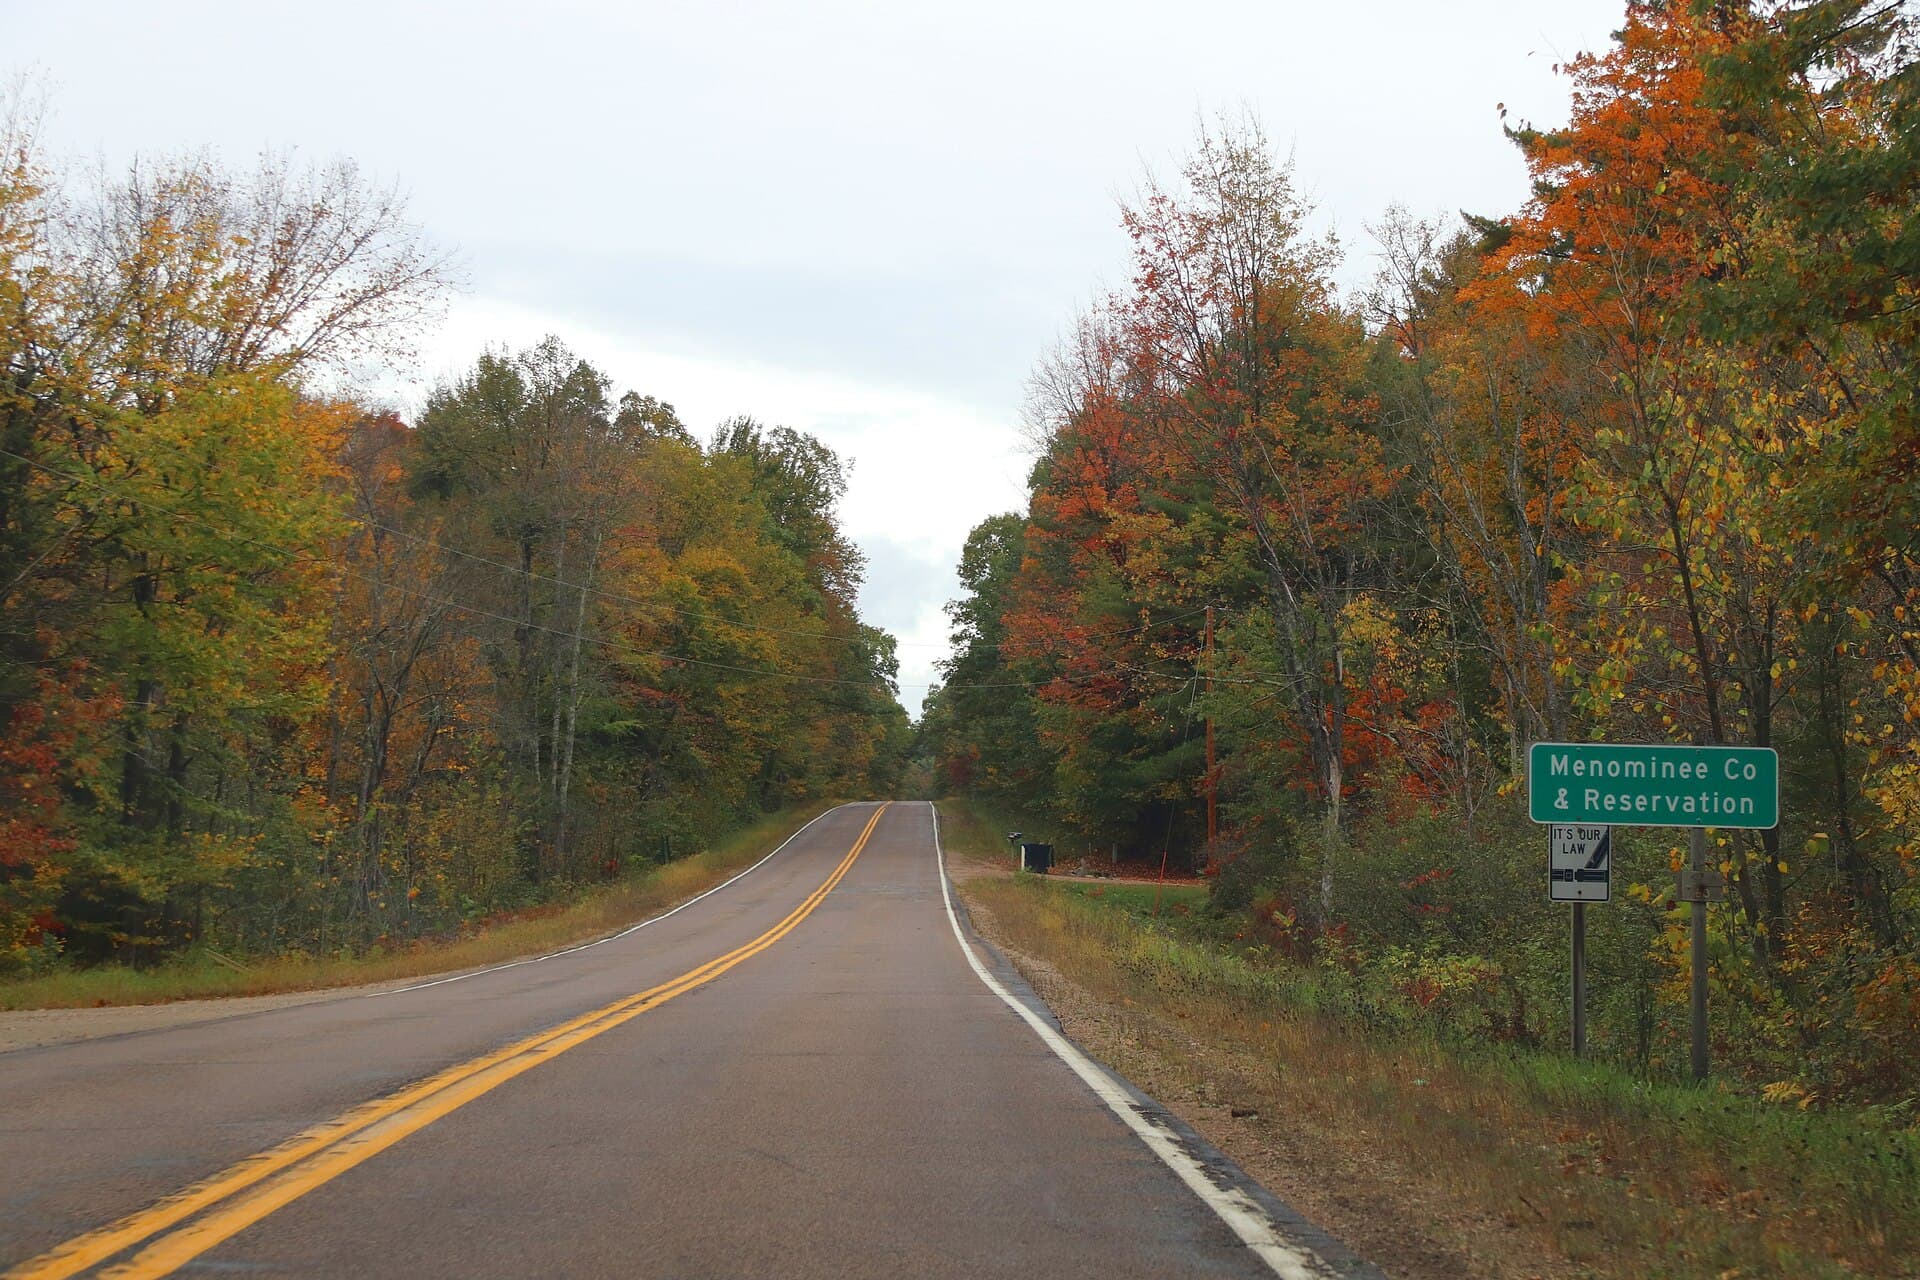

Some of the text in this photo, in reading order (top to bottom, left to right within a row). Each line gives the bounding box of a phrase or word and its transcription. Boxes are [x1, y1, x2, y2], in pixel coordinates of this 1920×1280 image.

[1551, 754, 1756, 780] Menominee Co
[1553, 787, 1754, 814] & Reservation
[1553, 828, 1600, 840] IT'S OUR
[1562, 843, 1585, 854] LAW
